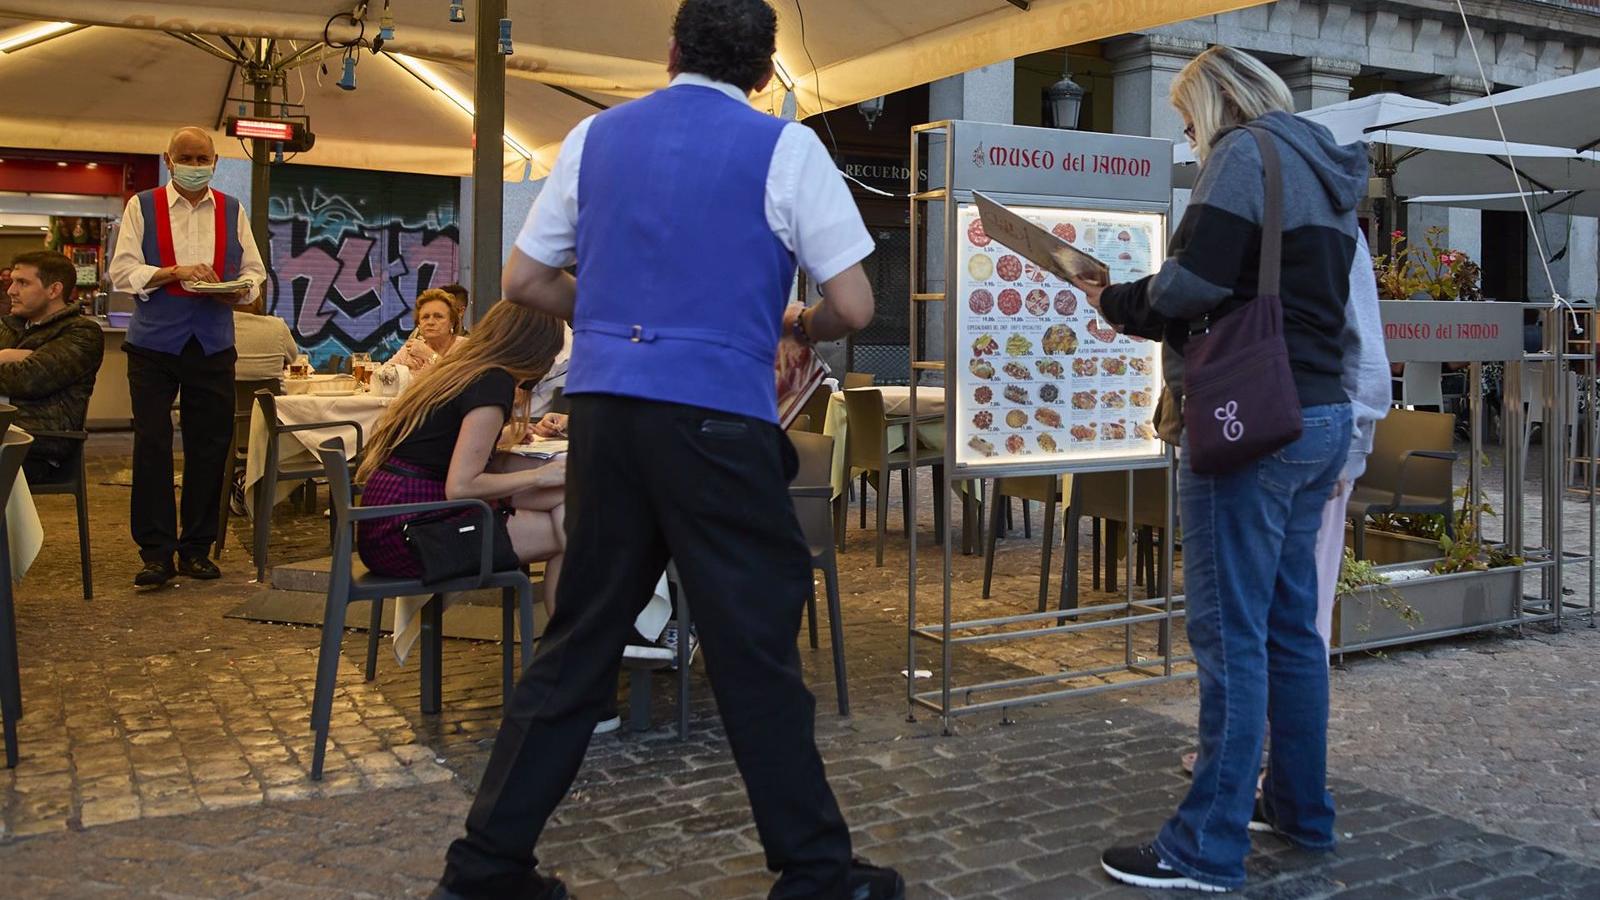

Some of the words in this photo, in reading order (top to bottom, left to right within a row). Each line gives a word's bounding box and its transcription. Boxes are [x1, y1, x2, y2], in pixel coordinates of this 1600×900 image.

[989, 146, 1055, 170] MUSEO
[1062, 152, 1086, 173] del
[845, 164, 928, 181] RECUERDS
[1385, 323, 1430, 339] MUSEO
[1436, 323, 1452, 339] del
